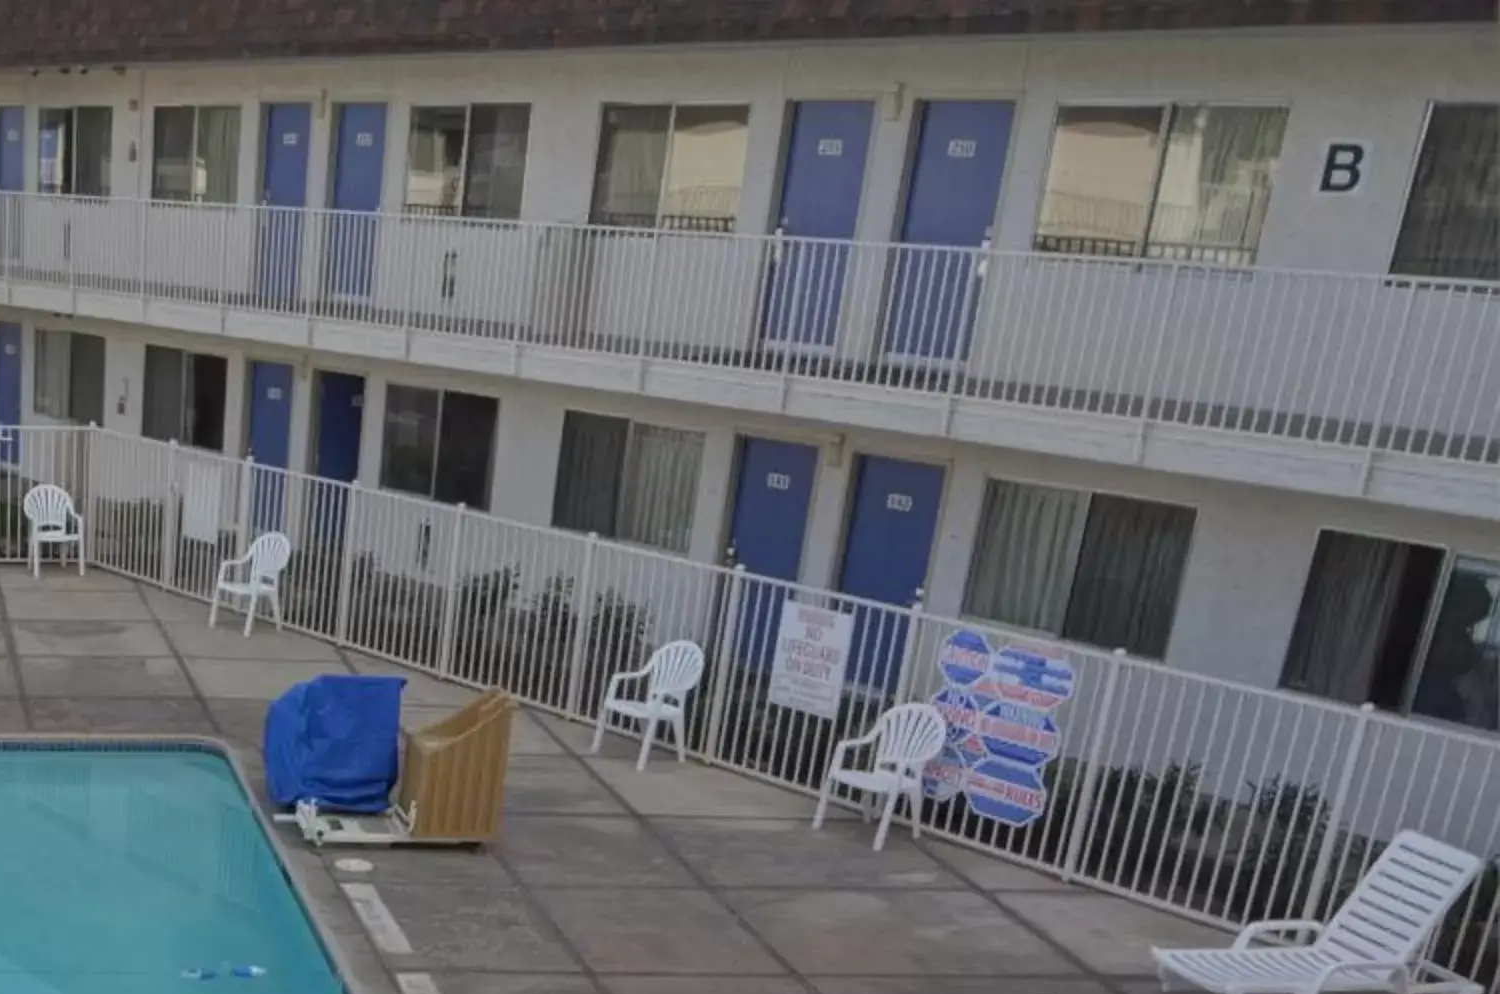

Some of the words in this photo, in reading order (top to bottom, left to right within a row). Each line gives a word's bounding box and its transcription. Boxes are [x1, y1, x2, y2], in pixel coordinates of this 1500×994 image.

[1320, 144, 1364, 192] B
[805, 625, 823, 642] NO
[780, 637, 840, 666] LIFEGUARD
[803, 662, 832, 681] DUTY
